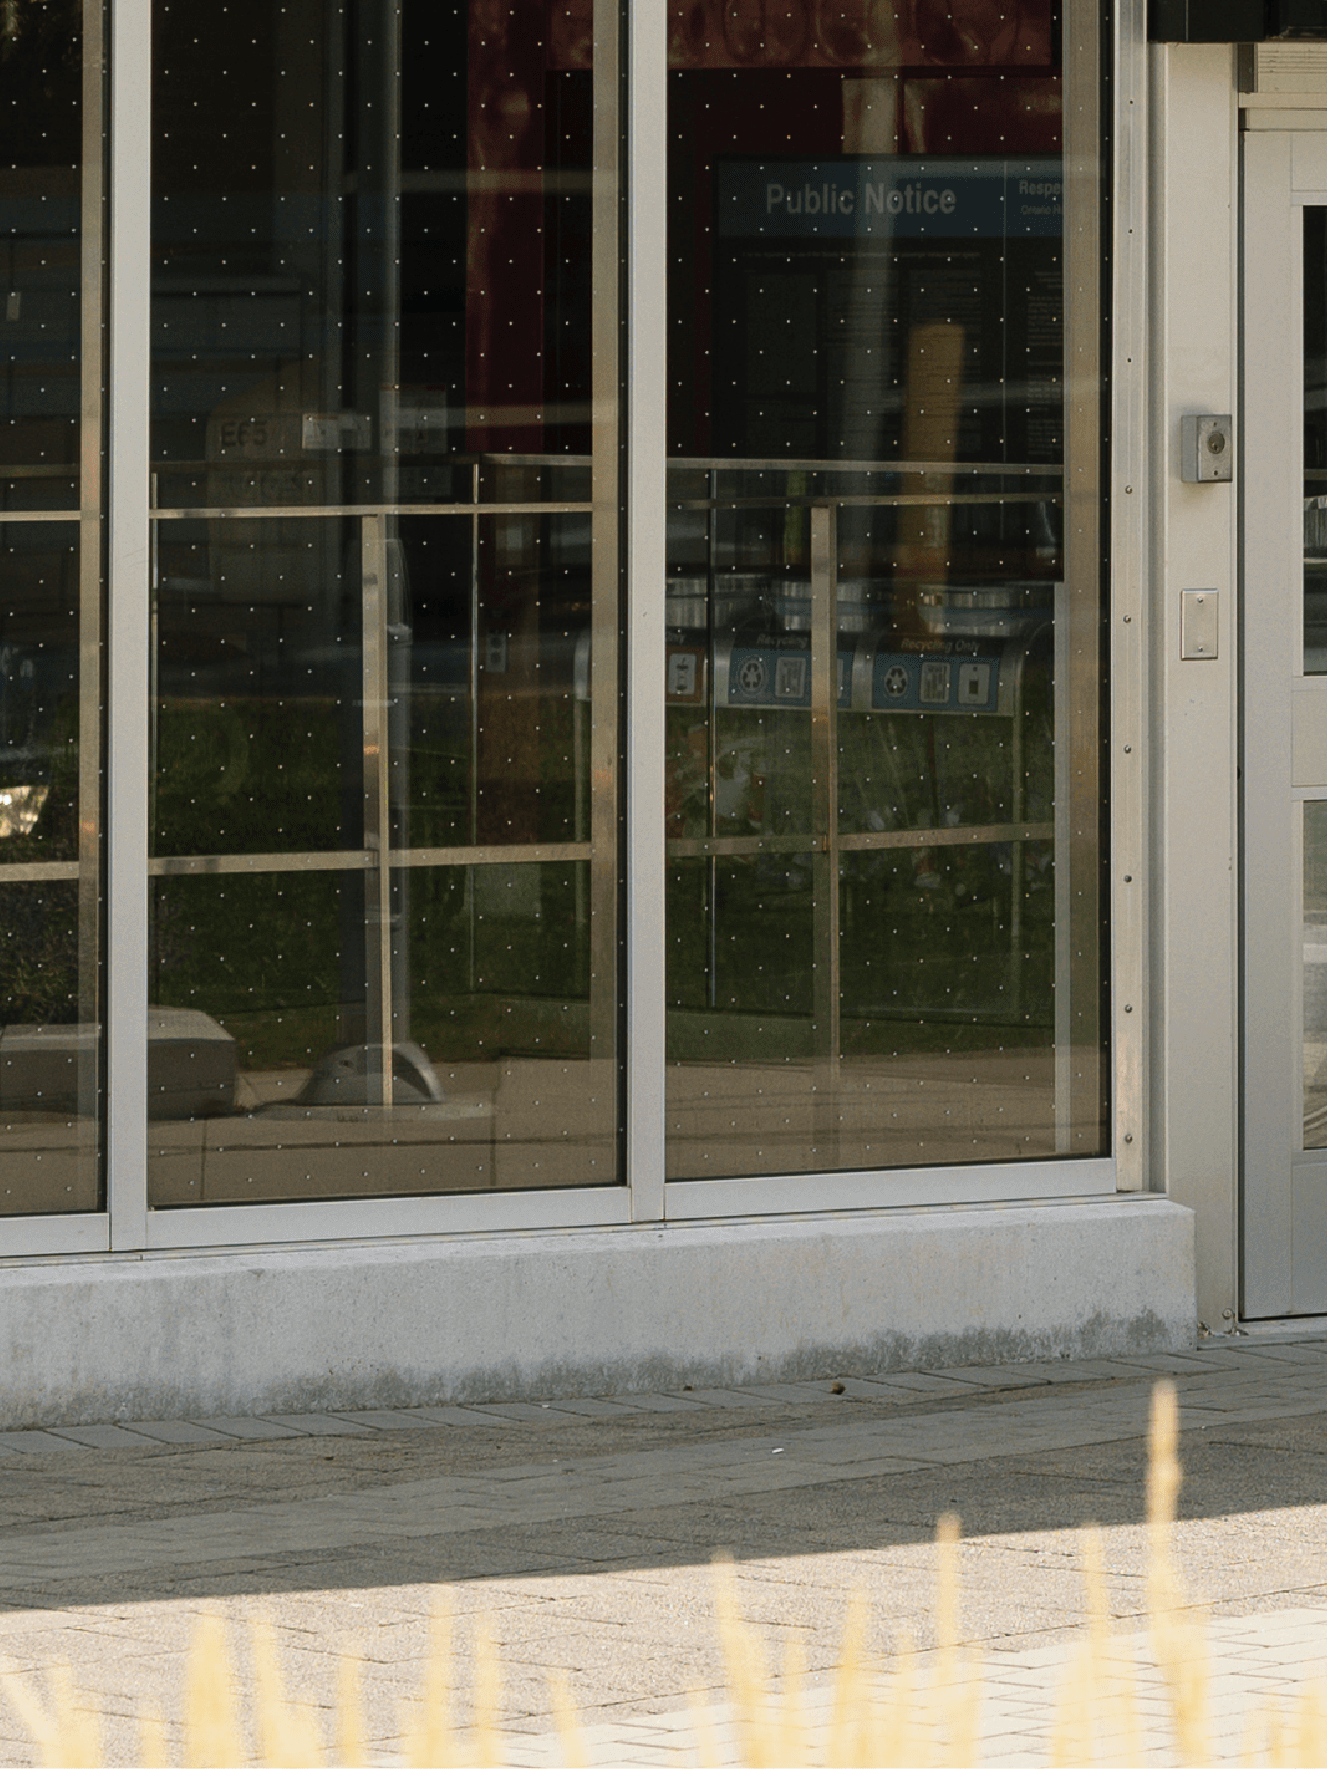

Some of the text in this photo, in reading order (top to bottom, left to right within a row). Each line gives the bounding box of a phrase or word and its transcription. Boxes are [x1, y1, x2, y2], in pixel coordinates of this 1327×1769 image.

[765, 182, 957, 215] Public Notice
[901, 637, 981, 654] Recycling Only
